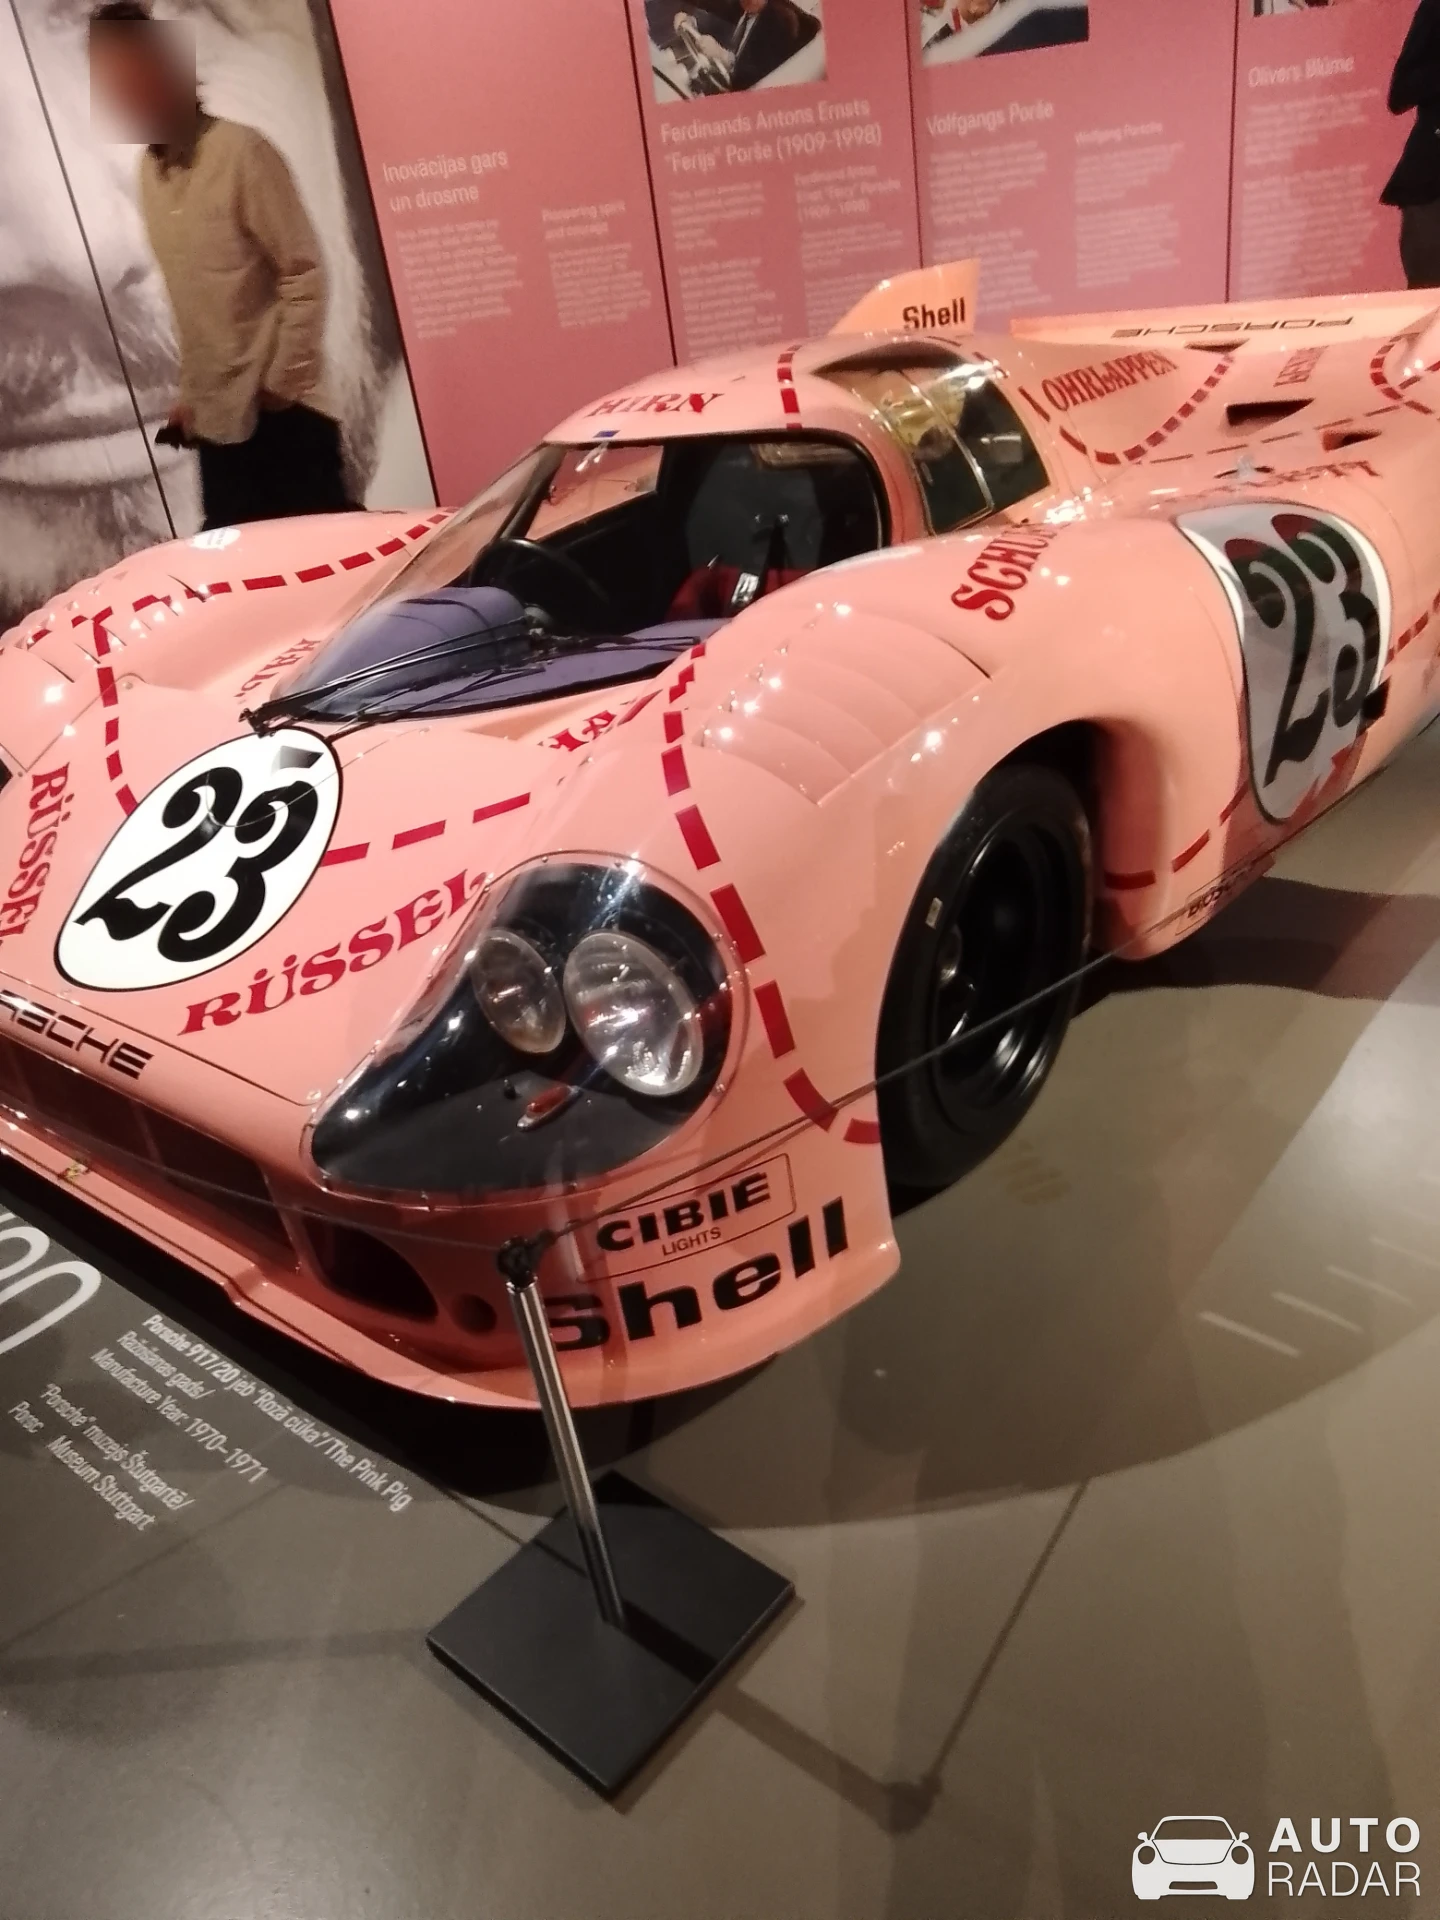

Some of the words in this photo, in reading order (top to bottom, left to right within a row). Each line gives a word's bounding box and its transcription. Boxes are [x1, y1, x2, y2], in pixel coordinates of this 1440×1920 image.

[660, 113, 751, 143] Ferdinands
[756, 104, 814, 130] Antons
[818, 98, 870, 121] Ernsts
[383, 154, 467, 184] Inovācijas
[471, 150, 509, 175] gars
[389, 194, 412, 212] un
[416, 184, 480, 208] drosme
[903, 298, 966, 329] Shell
[1111, 316, 1355, 339] PORSCHE
[586, 393, 725, 417] HIRN
[74, 767, 319, 963] 23
[177, 868, 488, 1036] RÜSSEL
[662, 1227, 722, 1256] LIGHTS
[117, 1330, 178, 1377] Ražošanas
[90, 1348, 162, 1404] Manufacture
[156, 1395, 189, 1426] Year:
[142, 1314, 192, 1352] Porsche
[185, 1343, 241, 1382] 917/20
[224, 1374, 257, 1397] jeb
[349, 1458, 388, 1491] Pink
[380, 1481, 413, 1512] Pig
[83, 1425, 130, 1462] muzejs
[46, 1435, 101, 1483] Museum
[92, 1474, 156, 1531] Stuttgart
